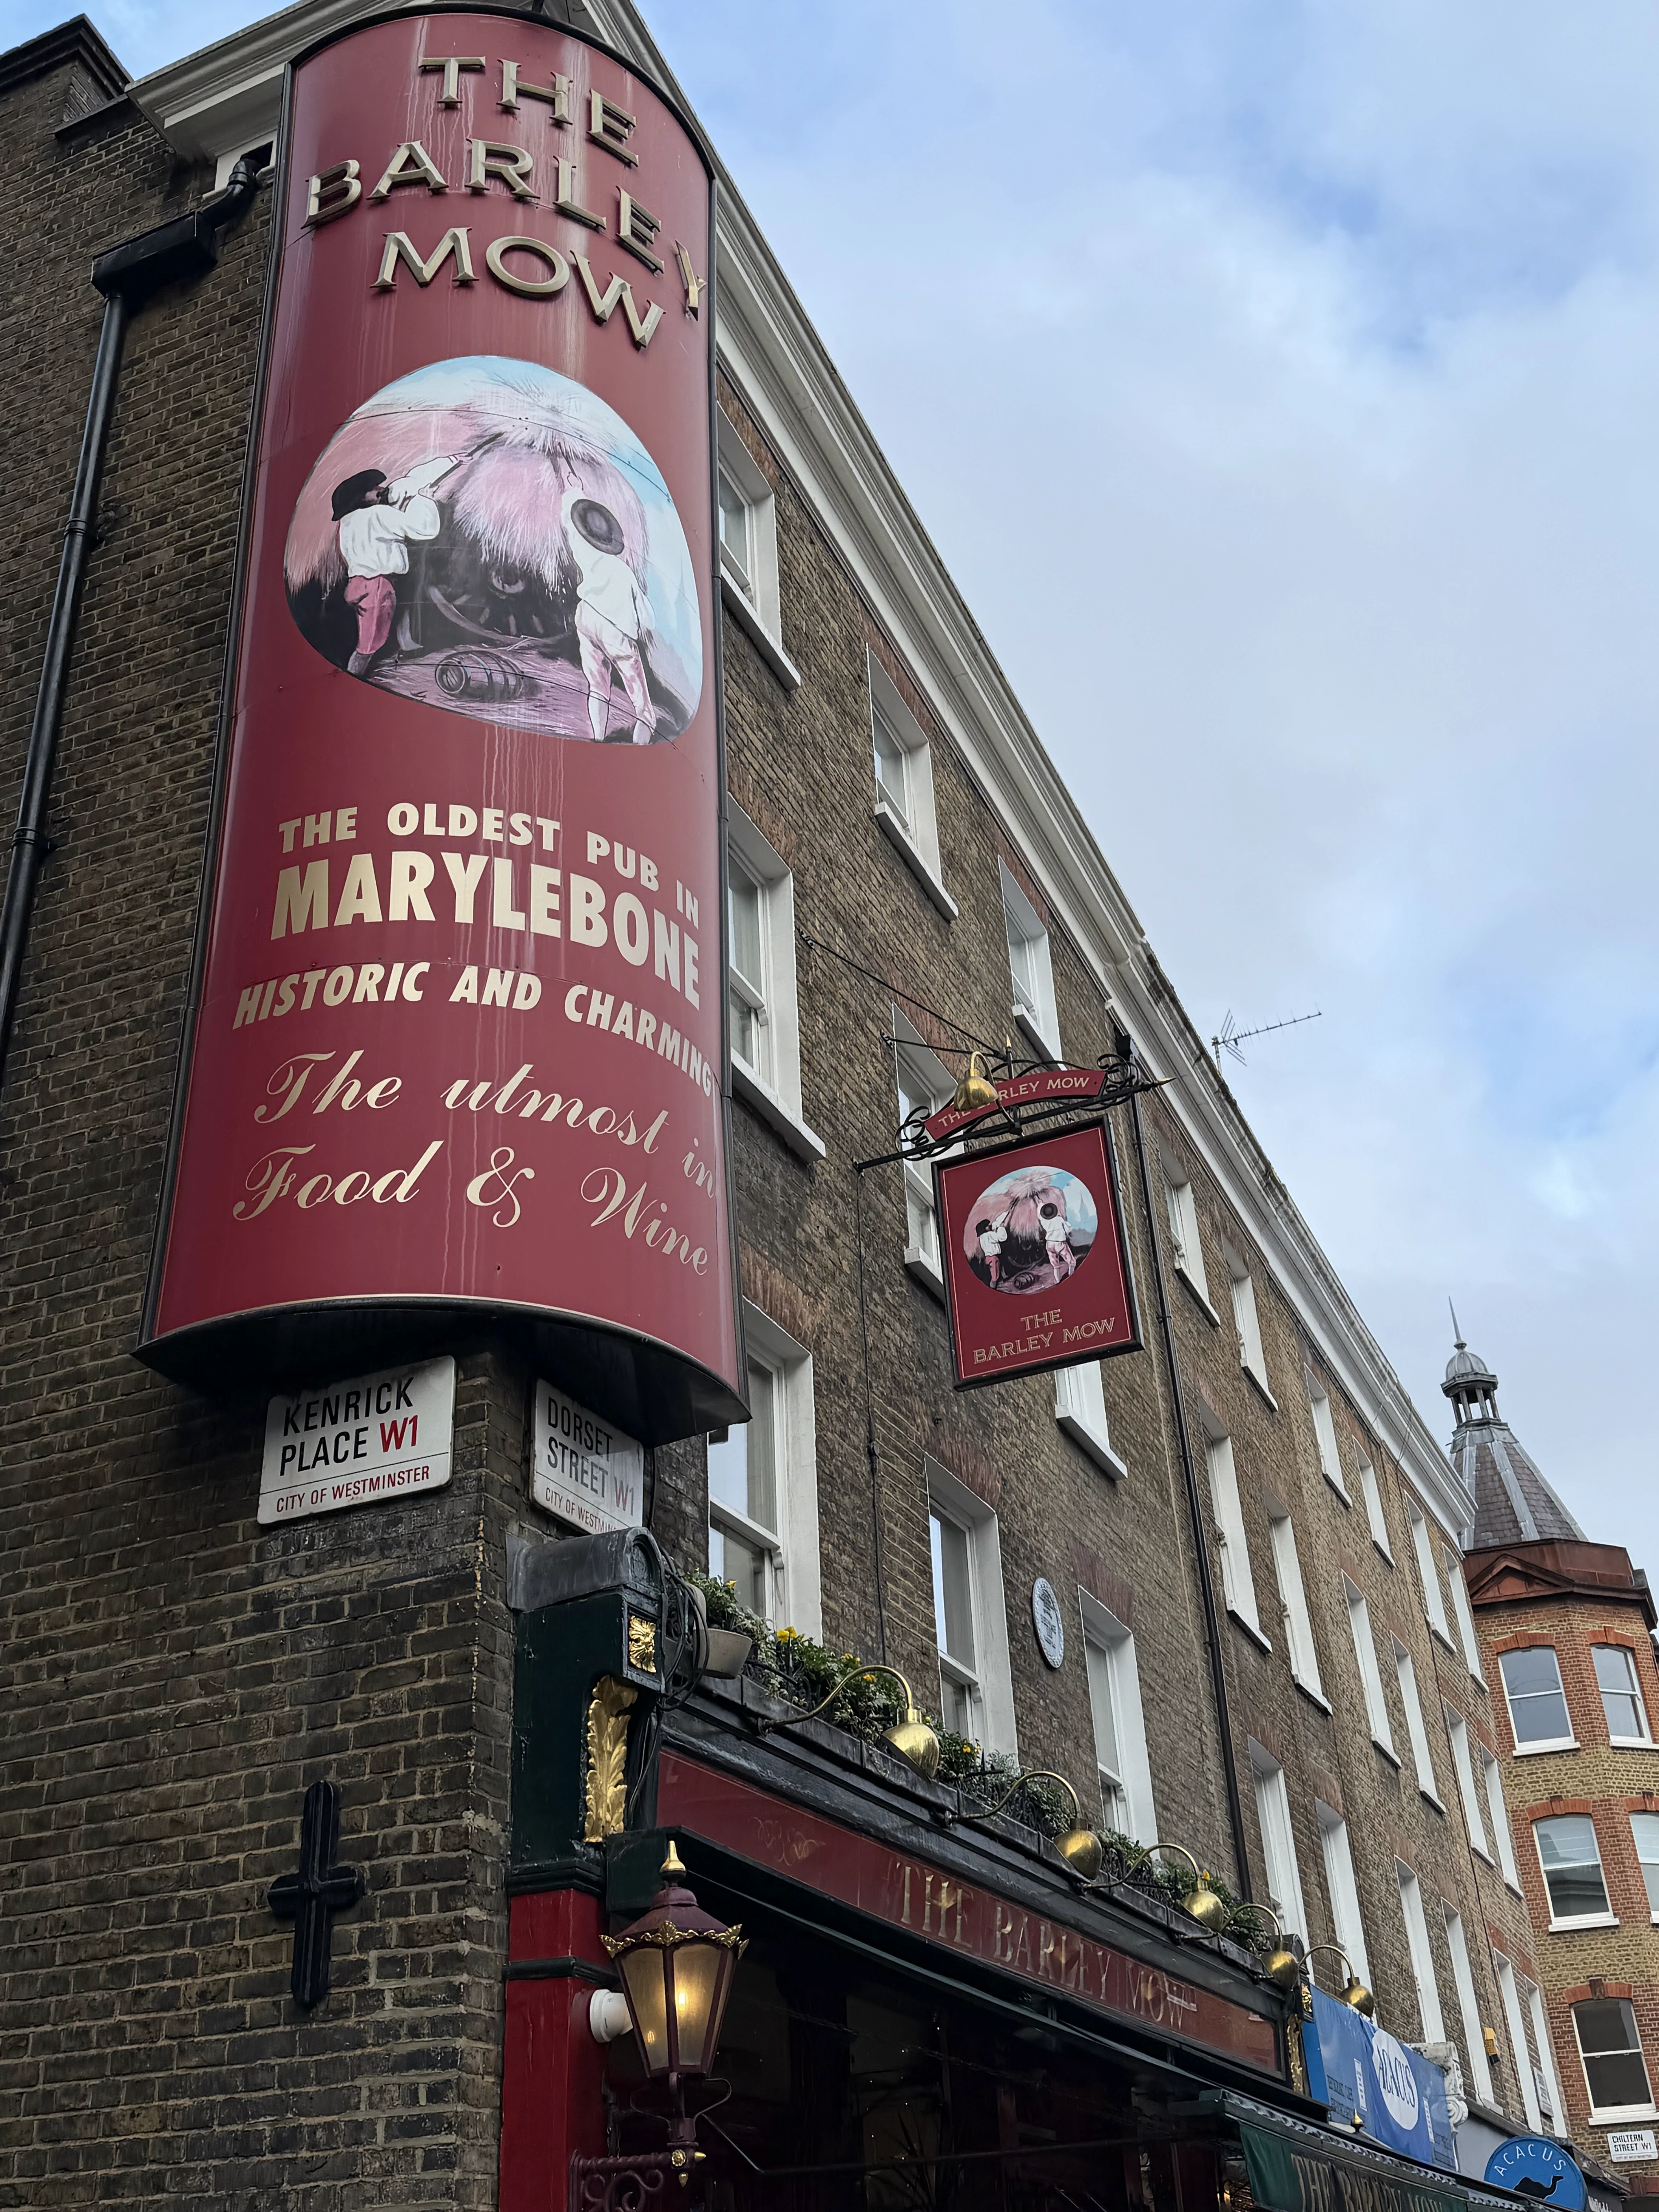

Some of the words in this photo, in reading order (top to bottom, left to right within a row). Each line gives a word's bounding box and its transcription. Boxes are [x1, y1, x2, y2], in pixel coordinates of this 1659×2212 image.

[418, 55, 639, 168] THE
[300, 138, 706, 321] BARLEY
[370, 227, 666, 349] MOW
[278, 806, 358, 854] THE
[387, 802, 560, 852] OLDEST
[586, 830, 659, 892] PUB
[676, 879, 699, 930] IN
[270, 850, 700, 1011] MARYLEBONE
[232, 962, 431, 1030] HISTORIC
[448, 964, 542, 1011] AND
[564, 985, 713, 1097] CHARMING
[1047, 1077, 1089, 1090] MOW
[254, 1049, 402, 1124] The
[440, 1063, 670, 1154] utmost
[682, 1138, 715, 1199] in
[232, 1140, 444, 1221] Food
[466, 1147, 535, 1228] &
[580, 1166, 708, 1276] Wine
[973, 1332, 1053, 1364] BARLEY
[1063, 1317, 1115, 1343] MOW
[1020, 1309, 1062, 1331] THE
[283, 1377, 414, 1437] KENRICK
[547, 1396, 613, 1462] DORSET
[280, 1426, 369, 1477] PLACE
[380, 1414, 419, 1453] W1
[547, 1436, 608, 1499] STREET
[614, 1475, 634, 1516] W1
[276, 1492, 306, 1513] CITY
[310, 1487, 327, 1505] OF
[332, 1465, 430, 1501] WESTMINSTER
[546, 1487, 563, 1508] CITY
[565, 1499, 575, 1516] OF
[578, 1505, 617, 1535] WESTMIN
[1494, 2144, 1566, 2177] ACACUS
[1612, 2134, 1643, 2143] CHILTERN
[1614, 2143, 1637, 2152] STREET
